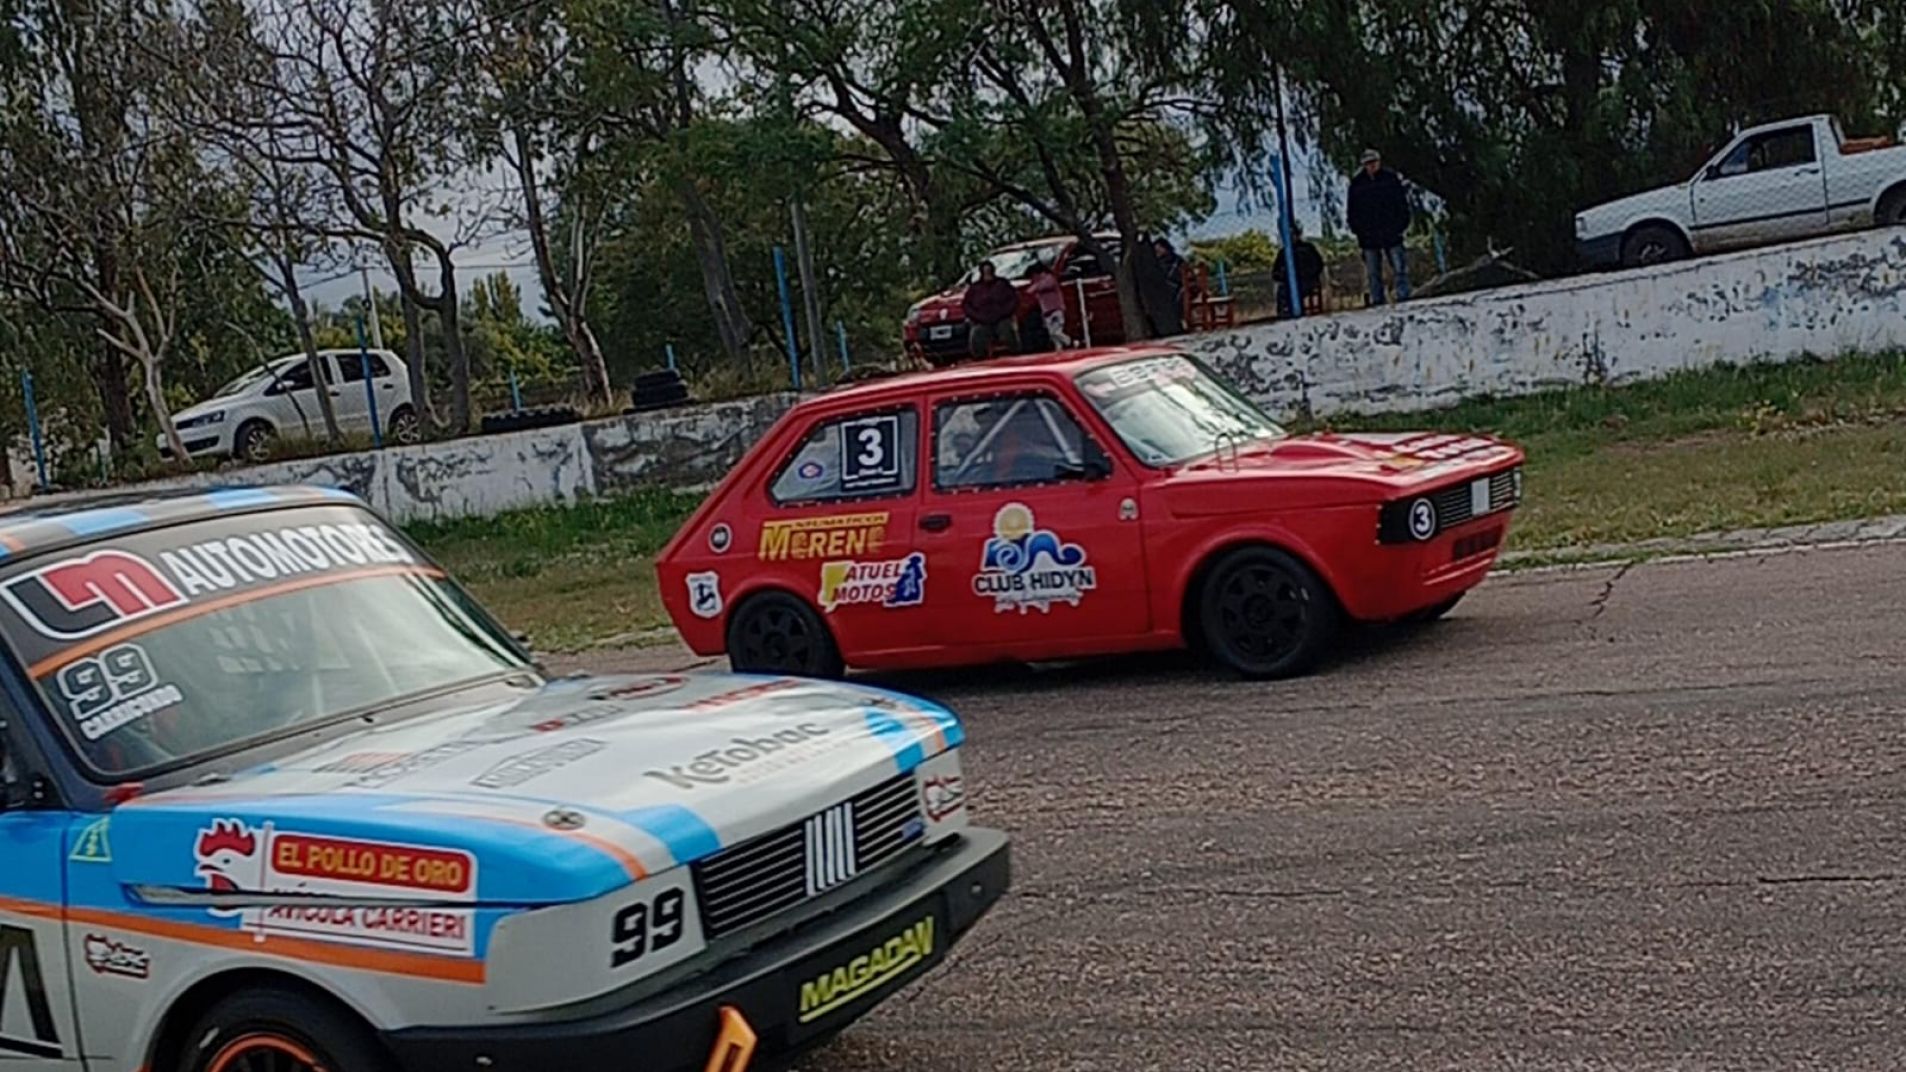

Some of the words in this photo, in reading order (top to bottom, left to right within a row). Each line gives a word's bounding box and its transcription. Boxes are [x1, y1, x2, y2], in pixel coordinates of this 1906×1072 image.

[858, 428, 884, 466] 3
[1415, 505, 1431, 532] 3
[159, 523, 414, 596] AUTOMOTORES
[843, 563, 901, 582] ATUEL
[833, 584, 897, 601] MOTOS
[975, 573, 1025, 592] CLUB
[57, 643, 159, 720] 99
[279, 842, 303, 867] EL
[309, 845, 377, 876] POLLO
[380, 854, 410, 881] DE
[414, 858, 463, 887] ORO
[361, 906, 467, 941] CARRIERI
[610, 887, 685, 969] 99
[800, 917, 935, 1011] MAGADAN
